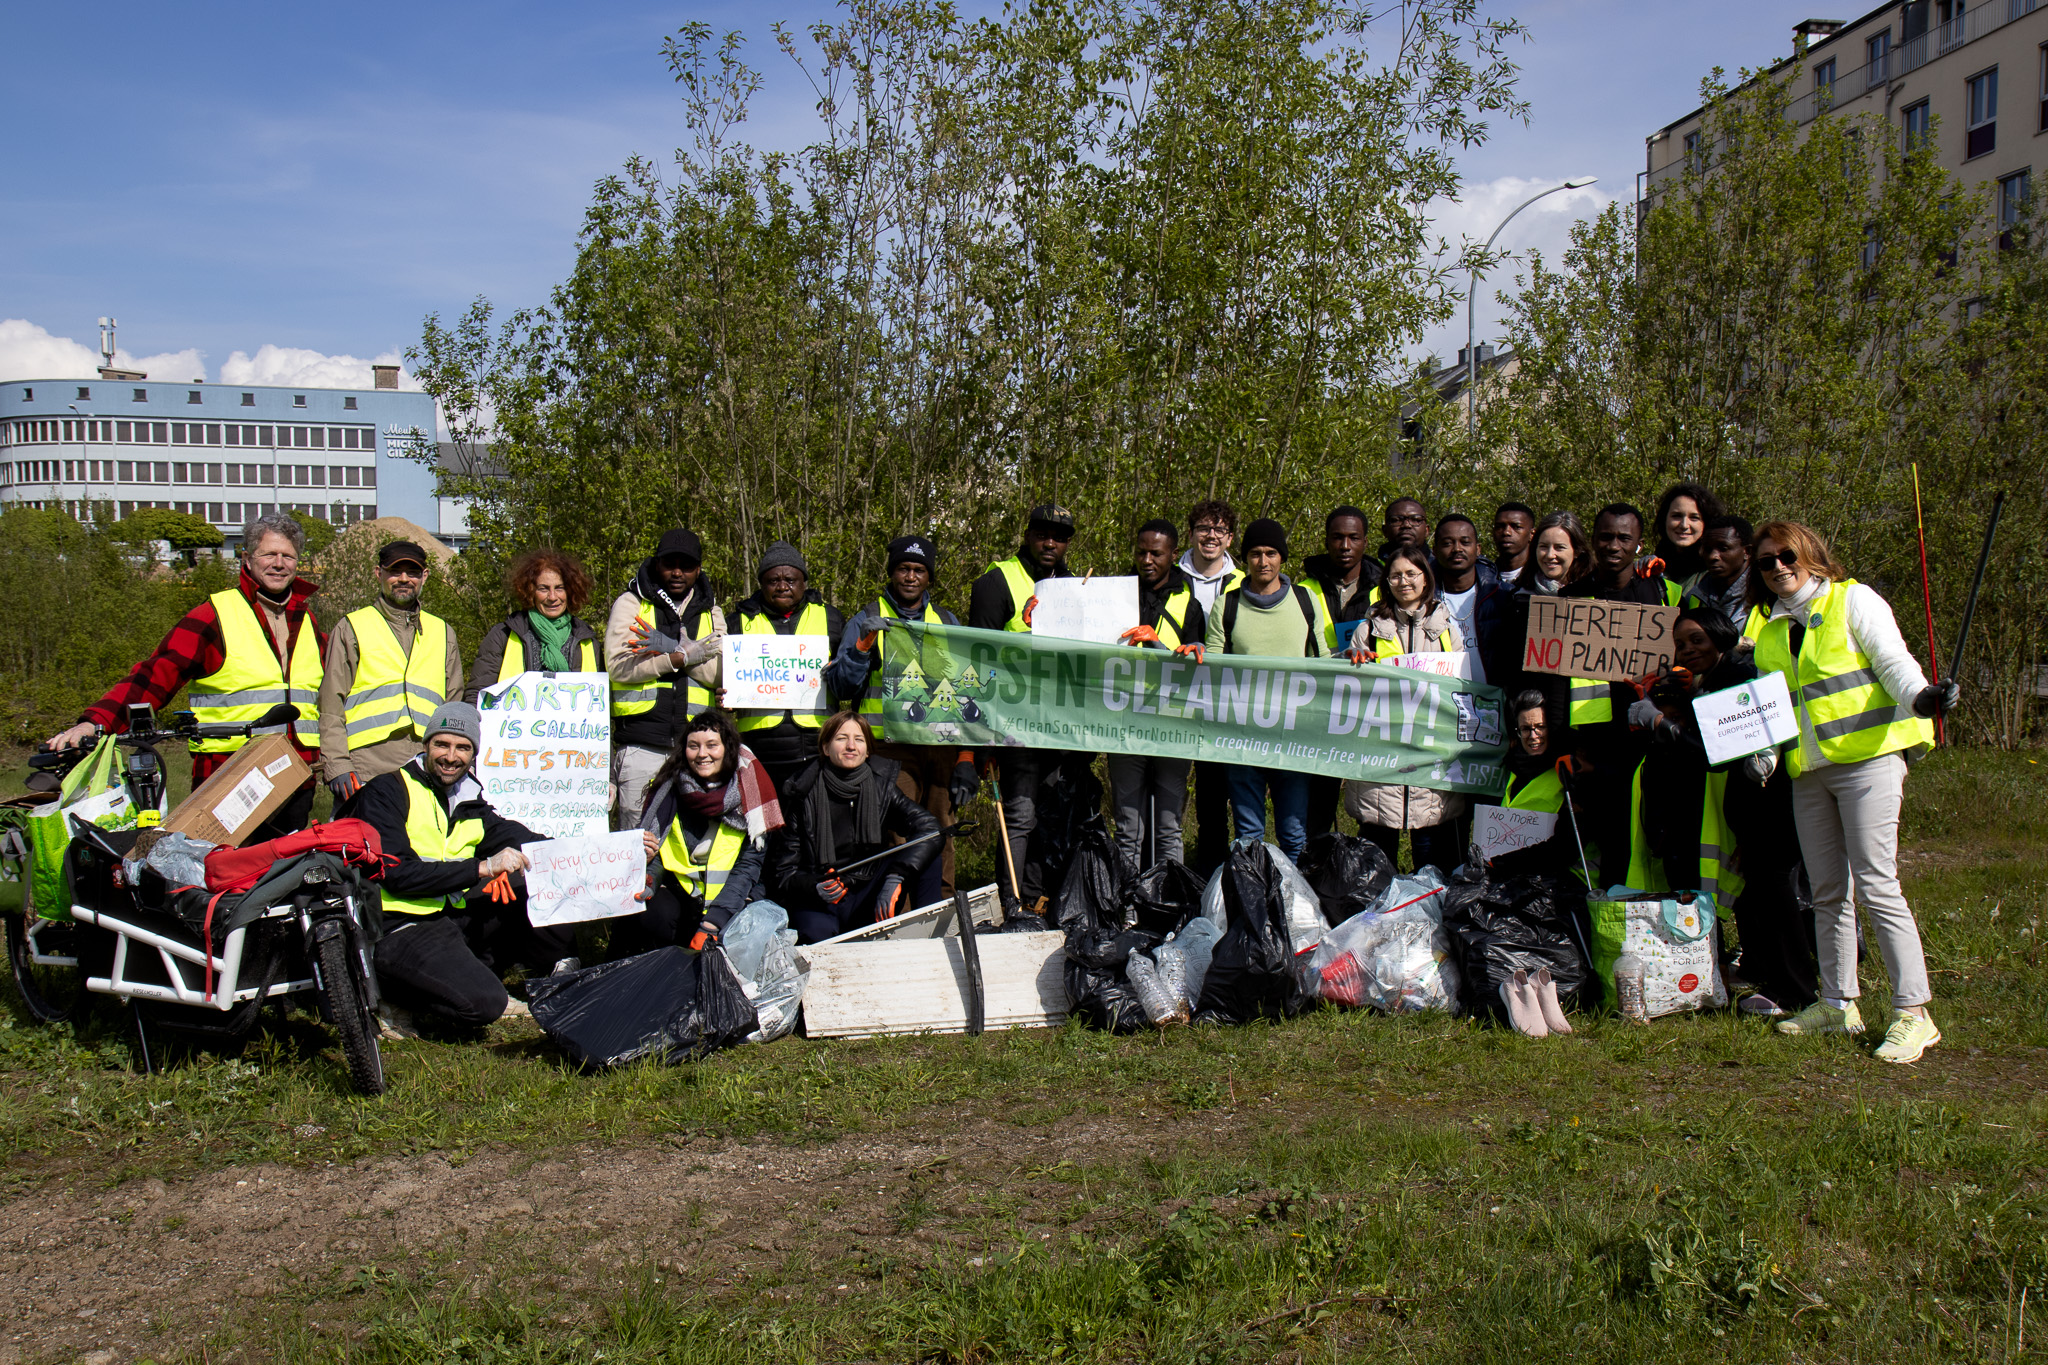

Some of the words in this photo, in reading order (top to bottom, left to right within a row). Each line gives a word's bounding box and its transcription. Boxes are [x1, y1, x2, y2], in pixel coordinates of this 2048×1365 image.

[1532, 601, 1627, 639] THERE
[1634, 609, 1666, 641] IS
[758, 656, 822, 669] TOGETHER
[1526, 637, 1563, 669] NO
[1570, 641, 1657, 676] PLANET
[736, 669, 790, 682] CHANGE
[757, 684, 787, 694] COME
[970, 642, 1086, 708] CSFN
[1103, 657, 1317, 730] CLEANUP
[1328, 674, 1441, 747] DAY!
[448, 718, 466, 729] CSFN
[1717, 722, 1754, 738] EUROPEAN
[1754, 711, 1781, 726] CLIMATE
[1718, 700, 1777, 726] AMBASSADORS
[1002, 717, 1205, 747] #CleanSomethingForNothing
[1744, 729, 1761, 740] PACT
[483, 746, 554, 771] LET'S
[558, 749, 609, 770] TAKE
[1215, 735, 1270, 756] creating
[1274, 744, 1282, 754] a
[1287, 740, 1355, 764] litter-free
[1360, 752, 1398, 768] world
[577, 778, 608, 796] FOR
[549, 802, 609, 819] COMMON
[1489, 812, 1504, 821] NO
[1509, 812, 1540, 826] MORE
[532, 847, 582, 876] Every
[589, 847, 634, 865] choice
[536, 886, 563, 902] has
[568, 884, 586, 899] an
[594, 868, 641, 893] impact
[1673, 957, 1691, 966] FOR
[1692, 955, 1706, 965] LIFE
